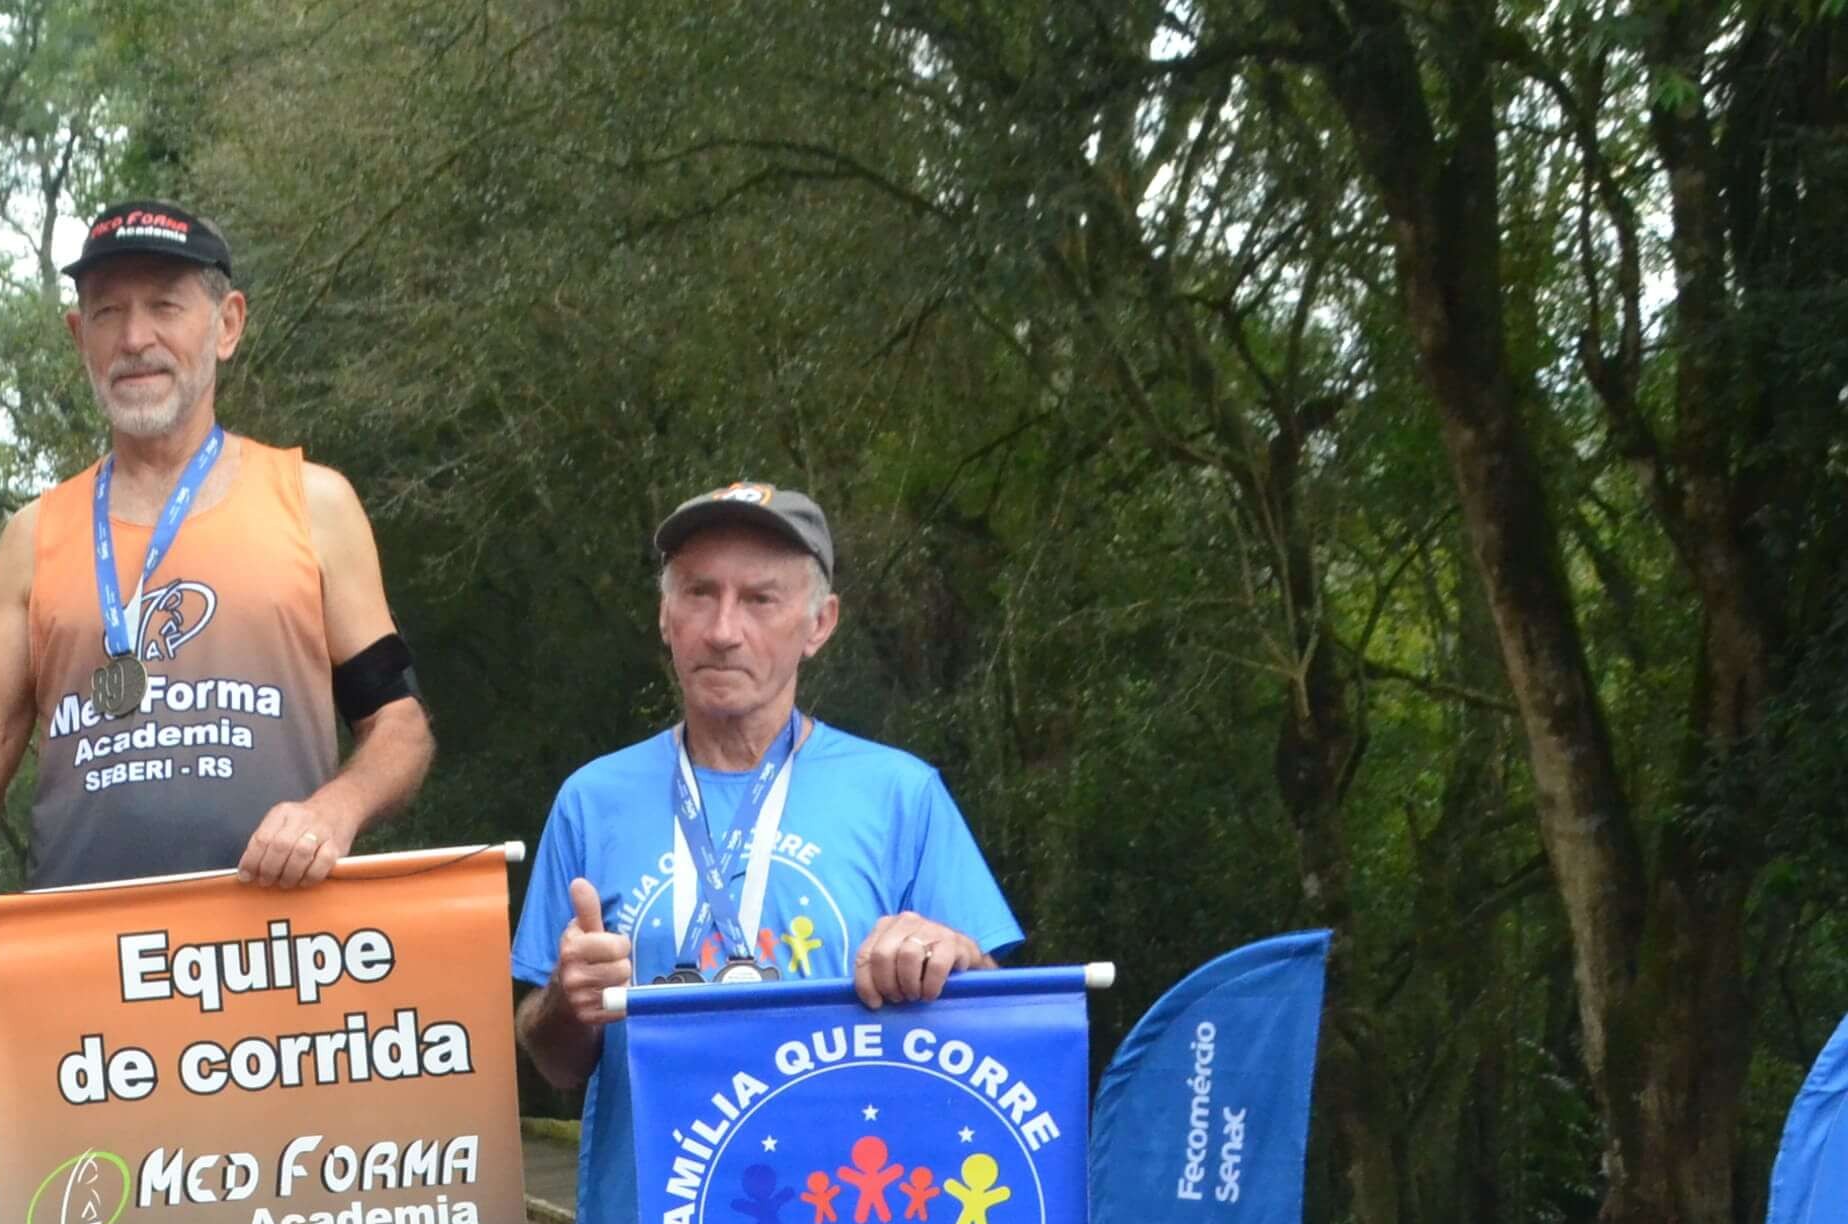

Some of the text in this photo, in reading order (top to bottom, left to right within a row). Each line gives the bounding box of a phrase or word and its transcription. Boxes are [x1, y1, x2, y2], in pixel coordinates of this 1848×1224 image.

[50, 675, 283, 739] Me Forma
[74, 718, 254, 767] Academia
[84, 758, 174, 792] SEBERI
[197, 755, 233, 779] RS
[117, 919, 395, 1013] Equipe
[58, 1008, 475, 1104] de corrida
[774, 1024, 883, 1077] QUE
[902, 1028, 1061, 1153] CORRE
[1177, 1020, 1218, 1201] Fecomércio
[1216, 1107, 1247, 1203] Senac
[276, 1134, 479, 1196] FORMA
